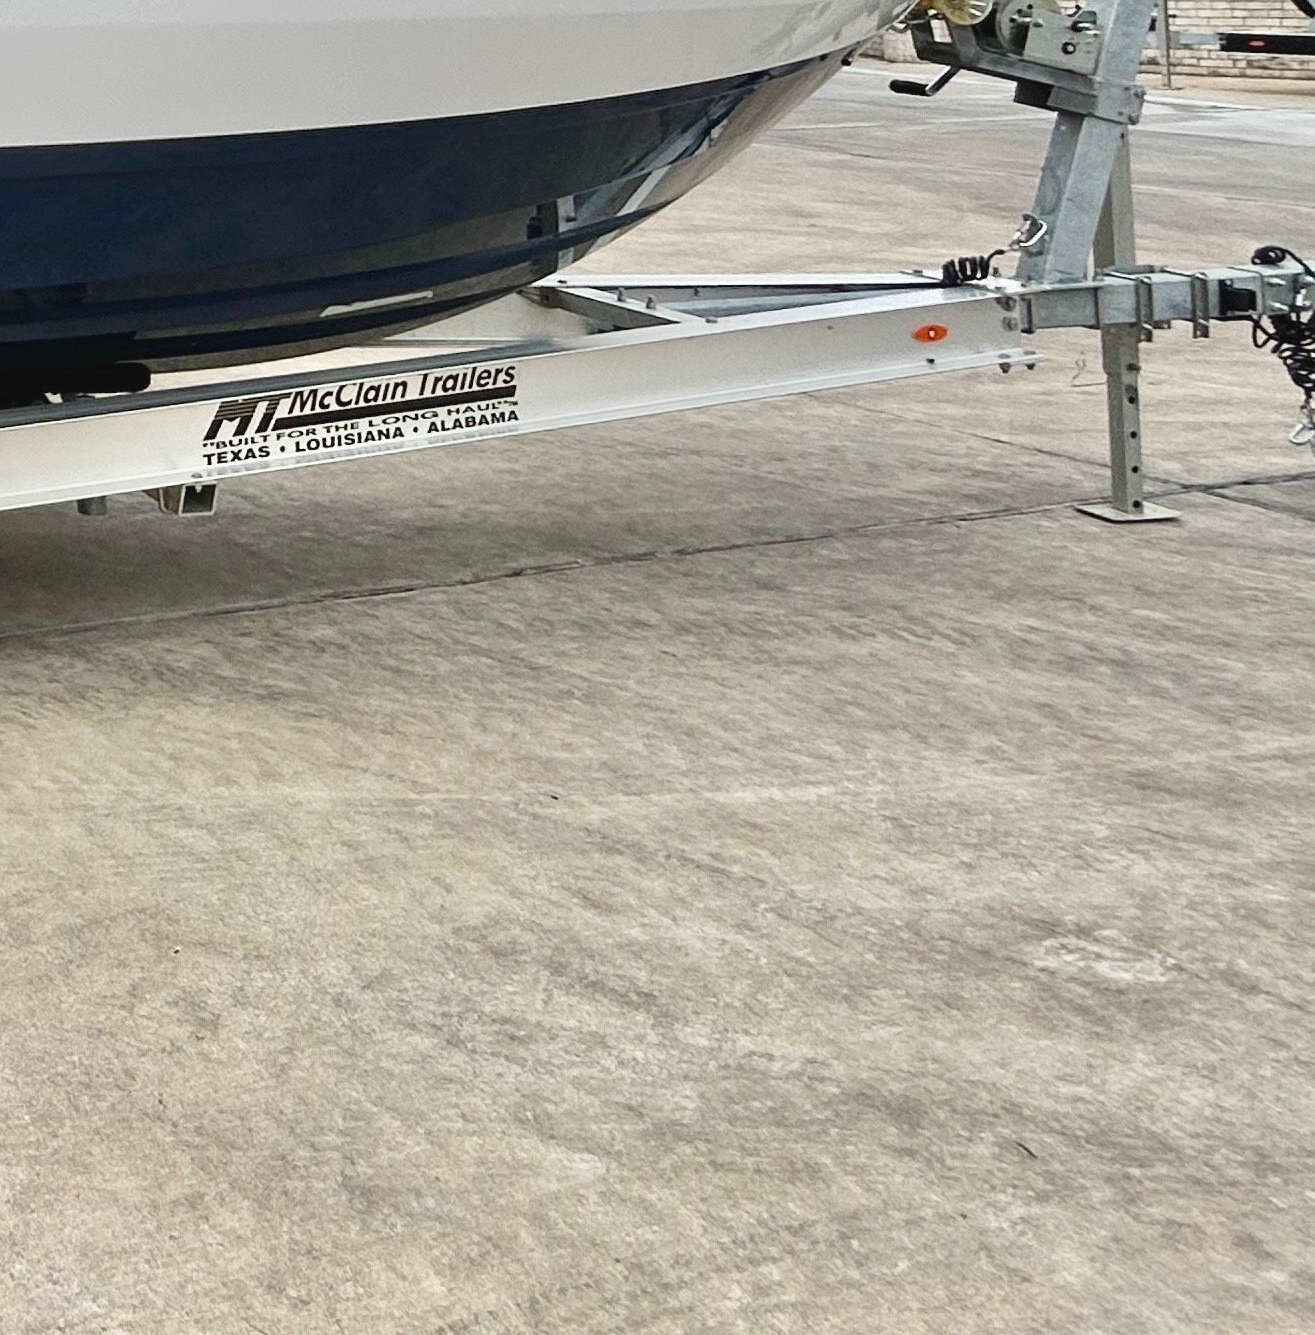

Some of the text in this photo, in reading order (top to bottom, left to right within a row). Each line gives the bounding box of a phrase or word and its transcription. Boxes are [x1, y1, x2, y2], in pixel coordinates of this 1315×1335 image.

[287, 380, 408, 414] McClain
[418, 365, 516, 397] Trailers
[202, 410, 519, 466] TEXAS LOUISIANA ALABAMA
[276, 427, 317, 441] FOR
[323, 421, 360, 434] THE
[368, 410, 439, 428] LONG
